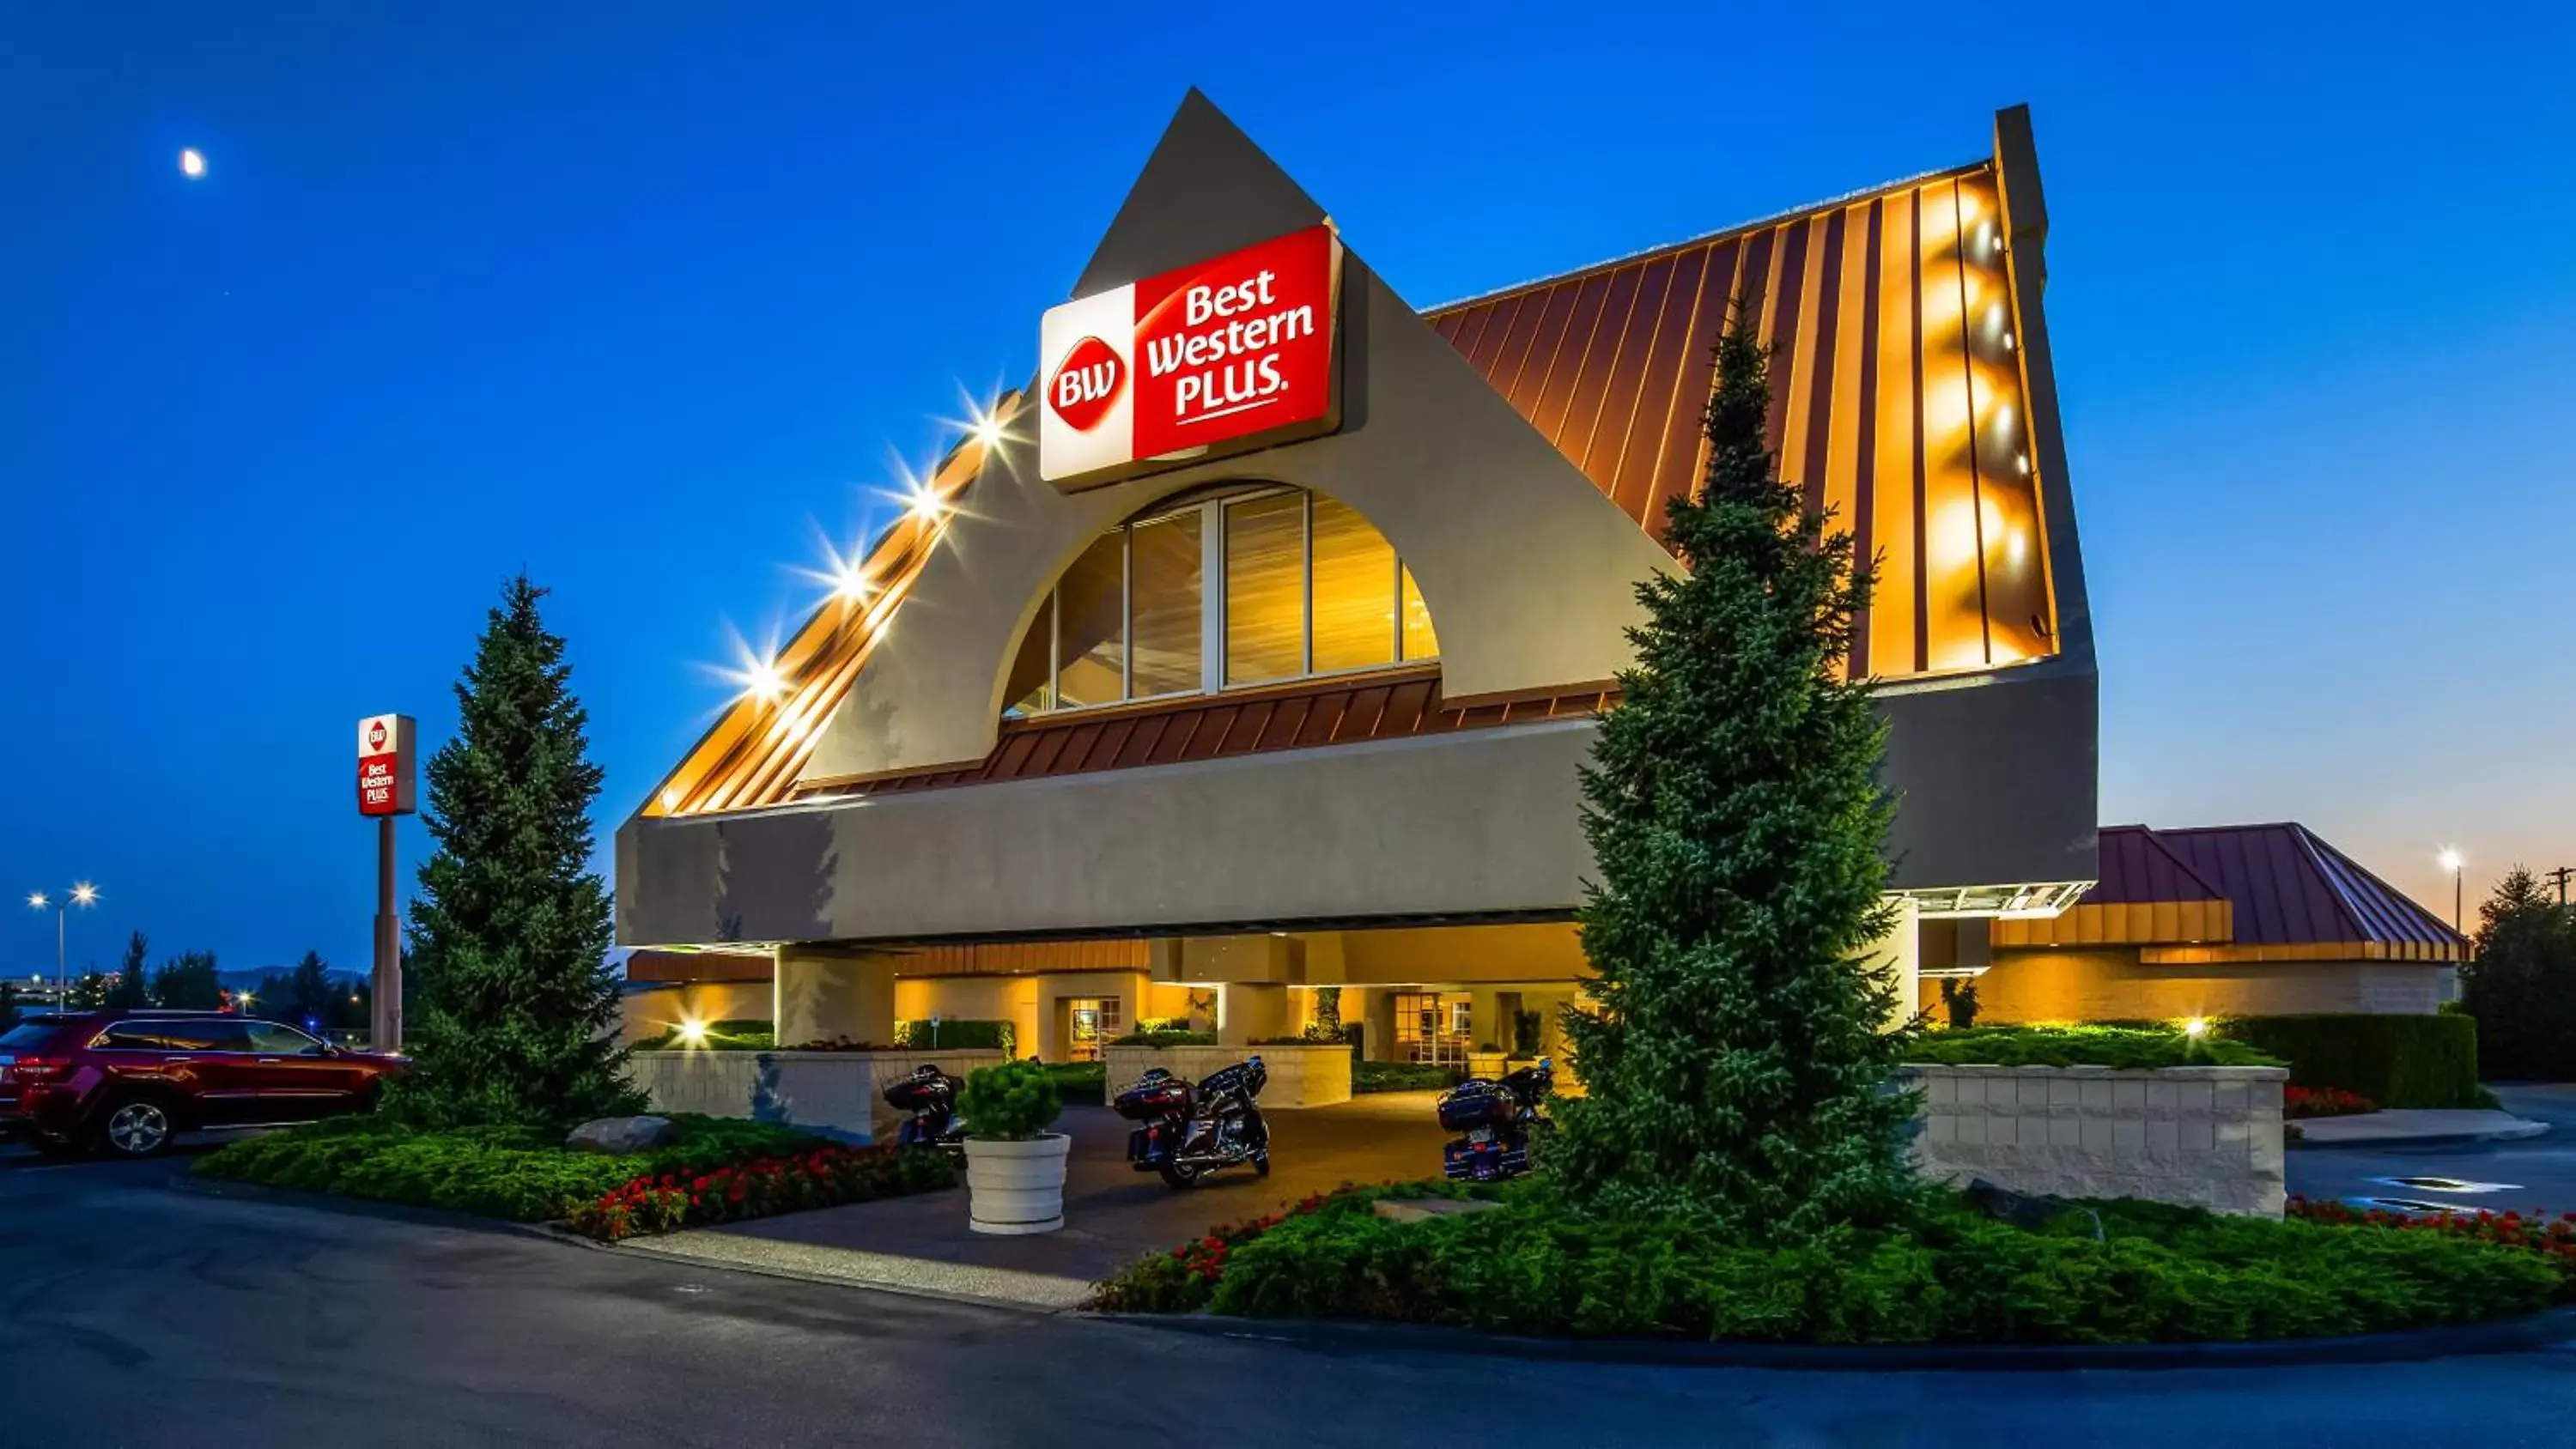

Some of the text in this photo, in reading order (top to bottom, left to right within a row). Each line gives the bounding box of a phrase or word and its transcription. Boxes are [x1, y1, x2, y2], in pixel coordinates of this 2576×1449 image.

[1186, 270, 1276, 326] Best
[1146, 304, 1315, 377] Western
[1059, 361, 1115, 408] BW
